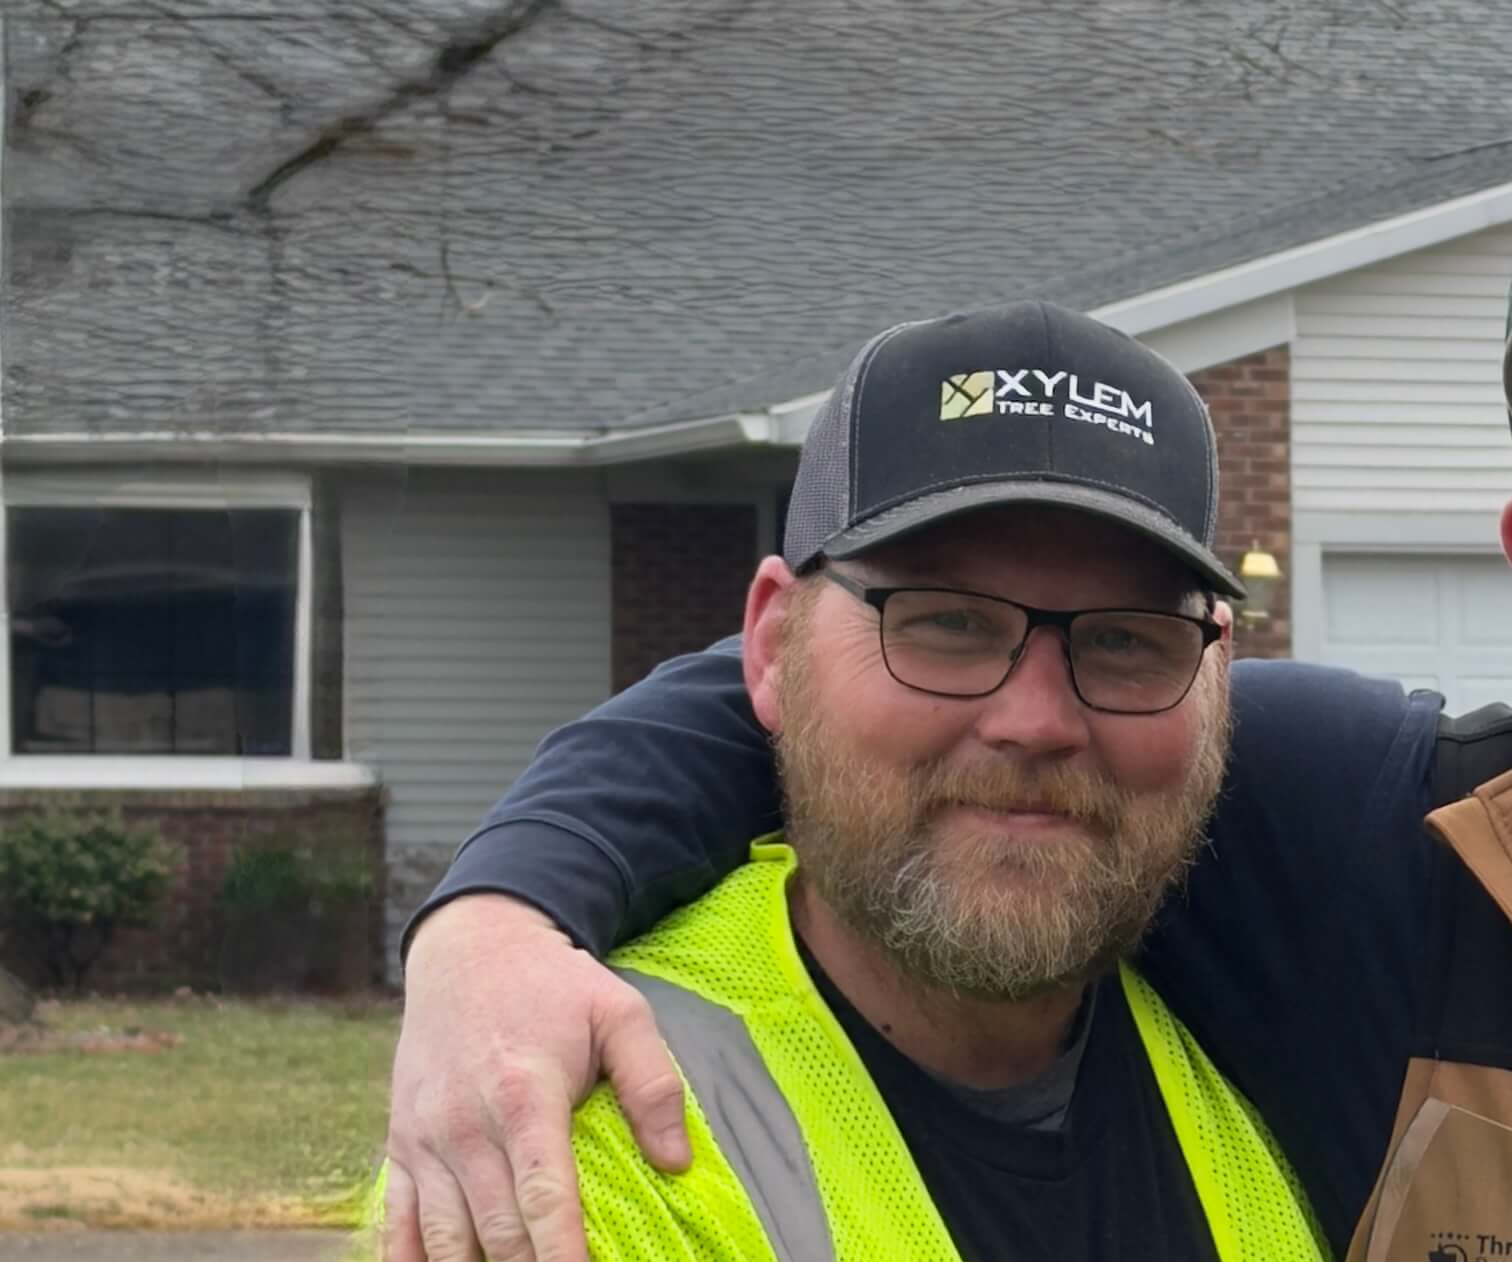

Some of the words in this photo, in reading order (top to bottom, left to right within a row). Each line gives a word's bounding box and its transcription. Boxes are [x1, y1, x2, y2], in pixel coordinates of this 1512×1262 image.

[995, 369, 1153, 427] XYLEM
[996, 401, 1055, 416] TREE
[1063, 403, 1155, 445] EXPERTS
